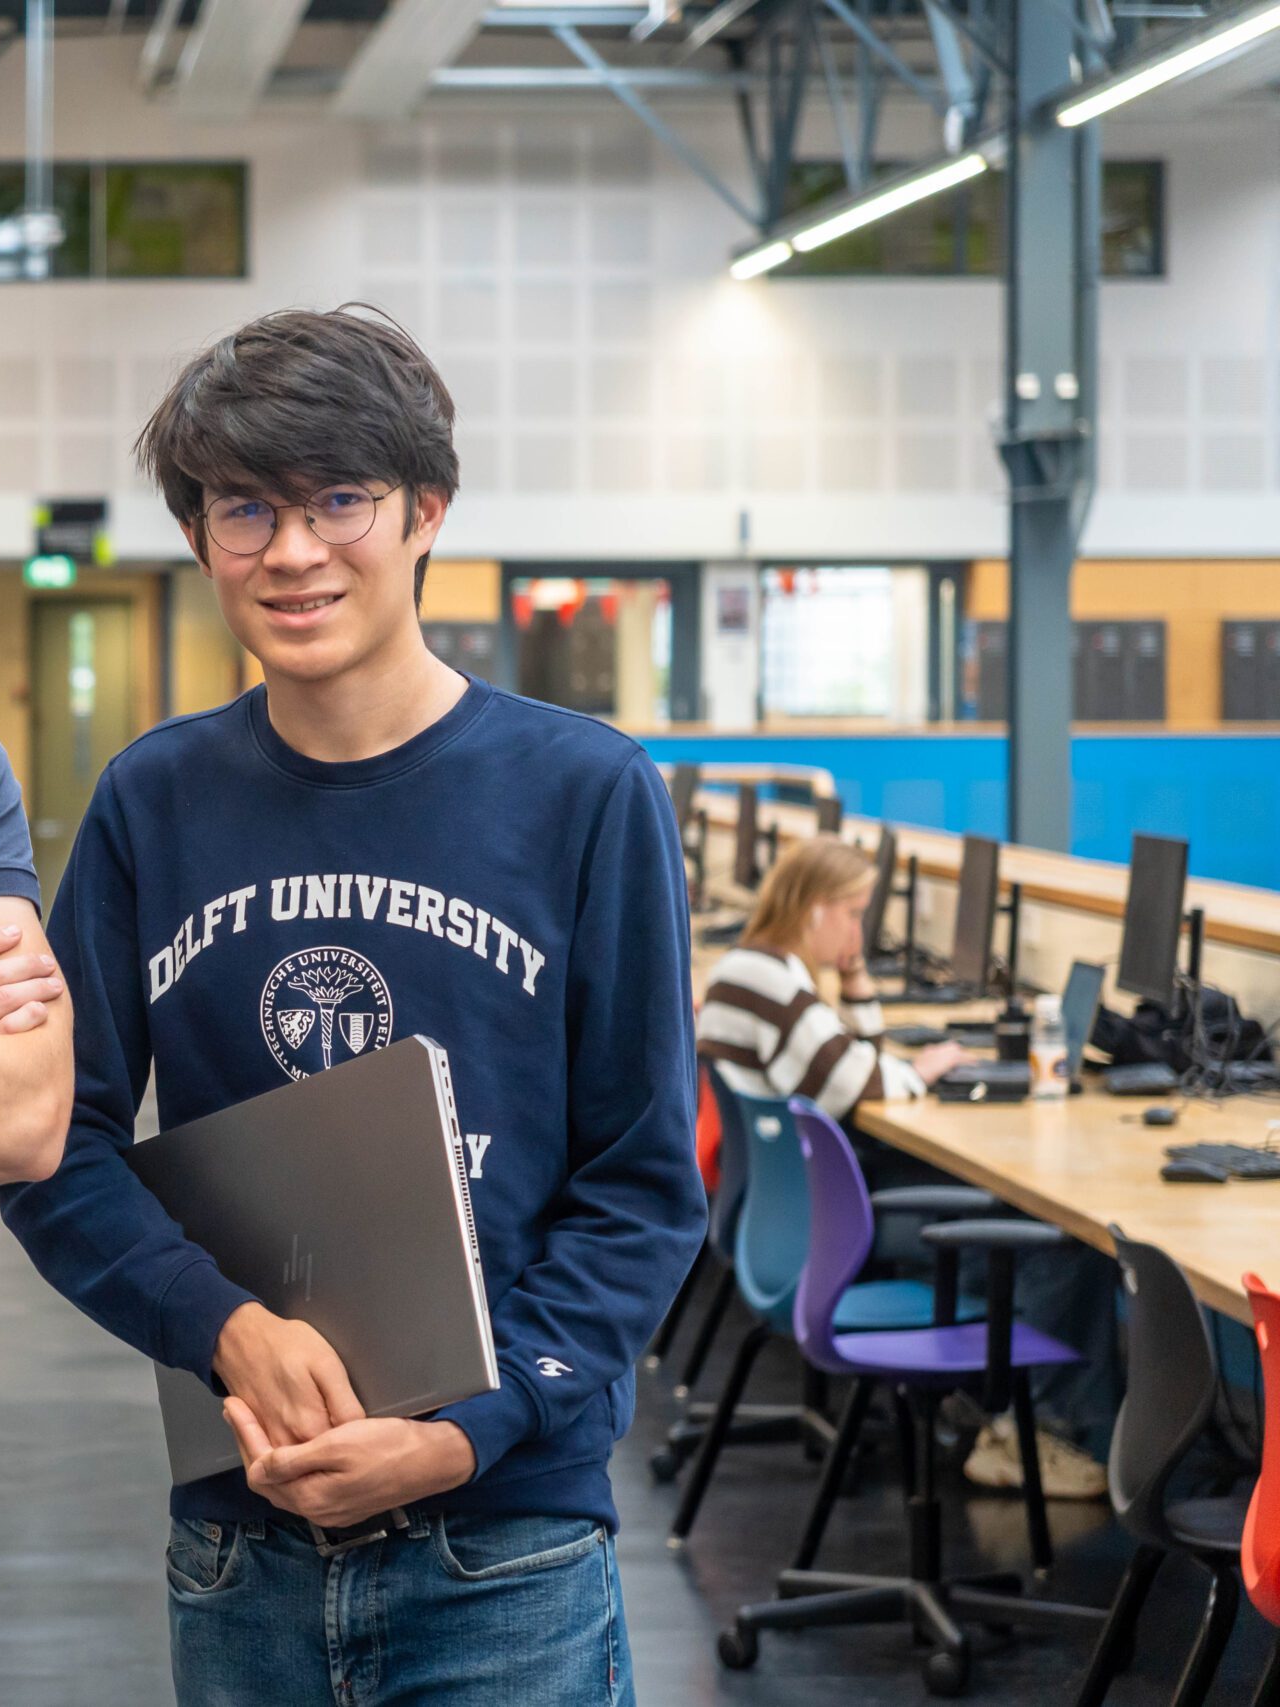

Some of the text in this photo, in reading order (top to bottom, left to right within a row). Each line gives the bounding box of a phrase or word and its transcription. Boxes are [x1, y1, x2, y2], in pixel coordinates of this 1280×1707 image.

[148, 873, 546, 1004] DELFT UNIVERSITY
[264, 961, 296, 1061] TECHNISCHE
[298, 951, 388, 1006] UNIVERSITEIT
